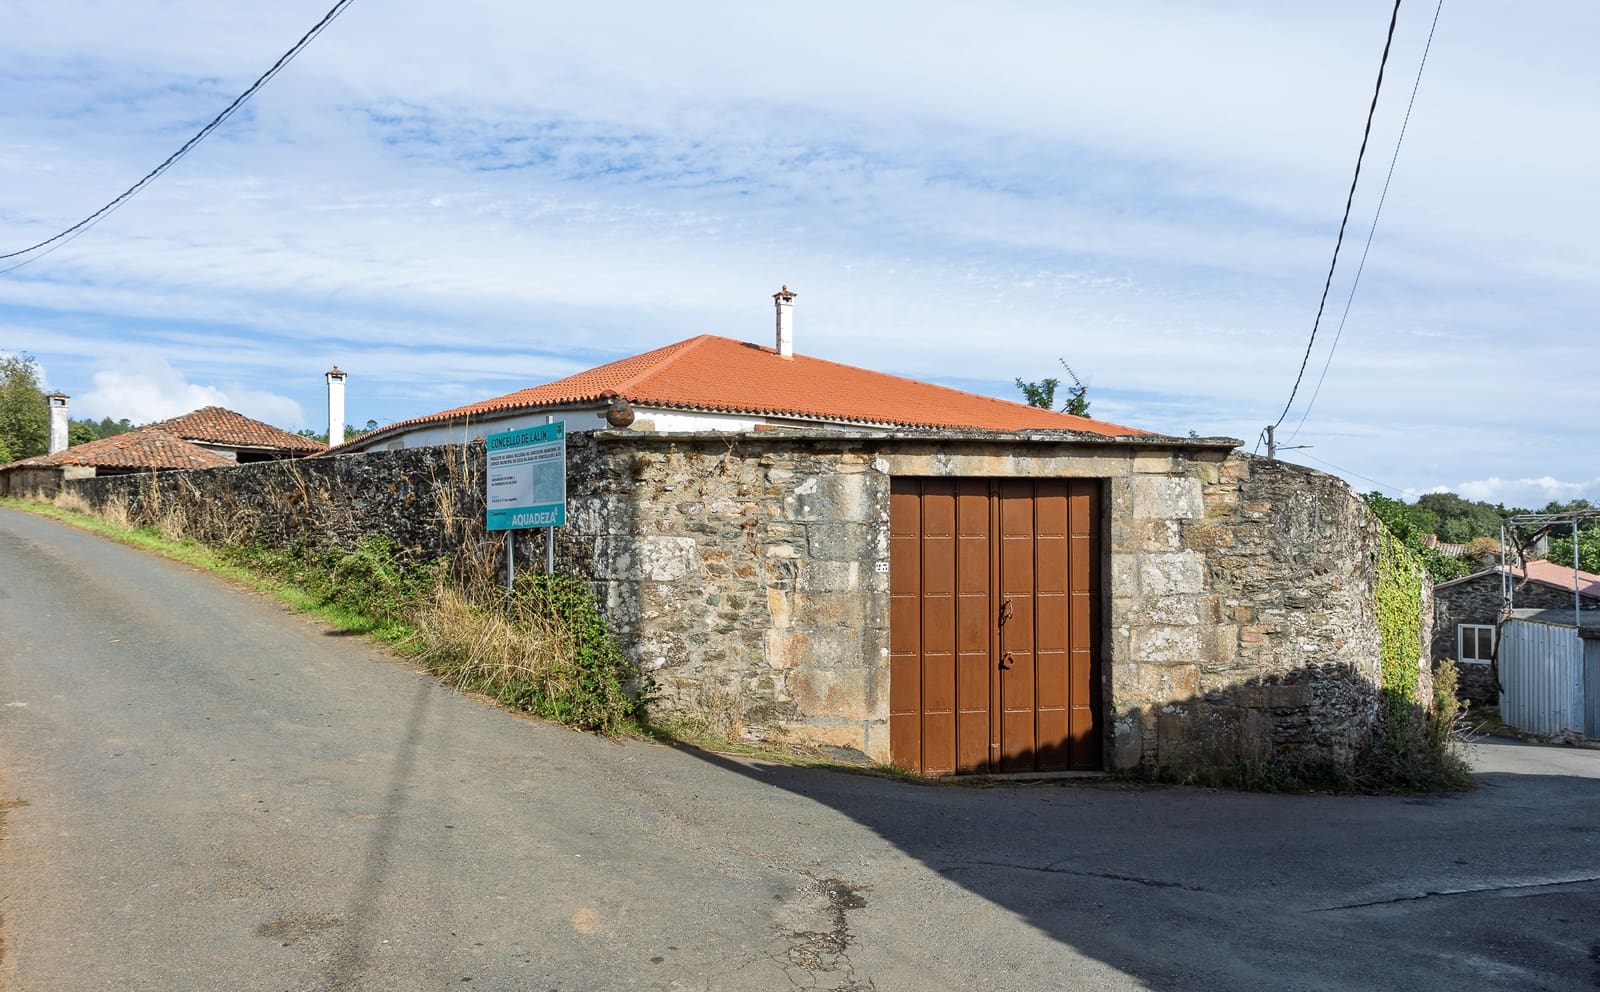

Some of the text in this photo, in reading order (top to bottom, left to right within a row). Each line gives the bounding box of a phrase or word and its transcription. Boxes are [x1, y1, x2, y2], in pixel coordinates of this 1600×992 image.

[491, 434, 520, 449] CONCELLO
[521, 433, 529, 444] DE
[512, 511, 557, 527] AQUADEZA
